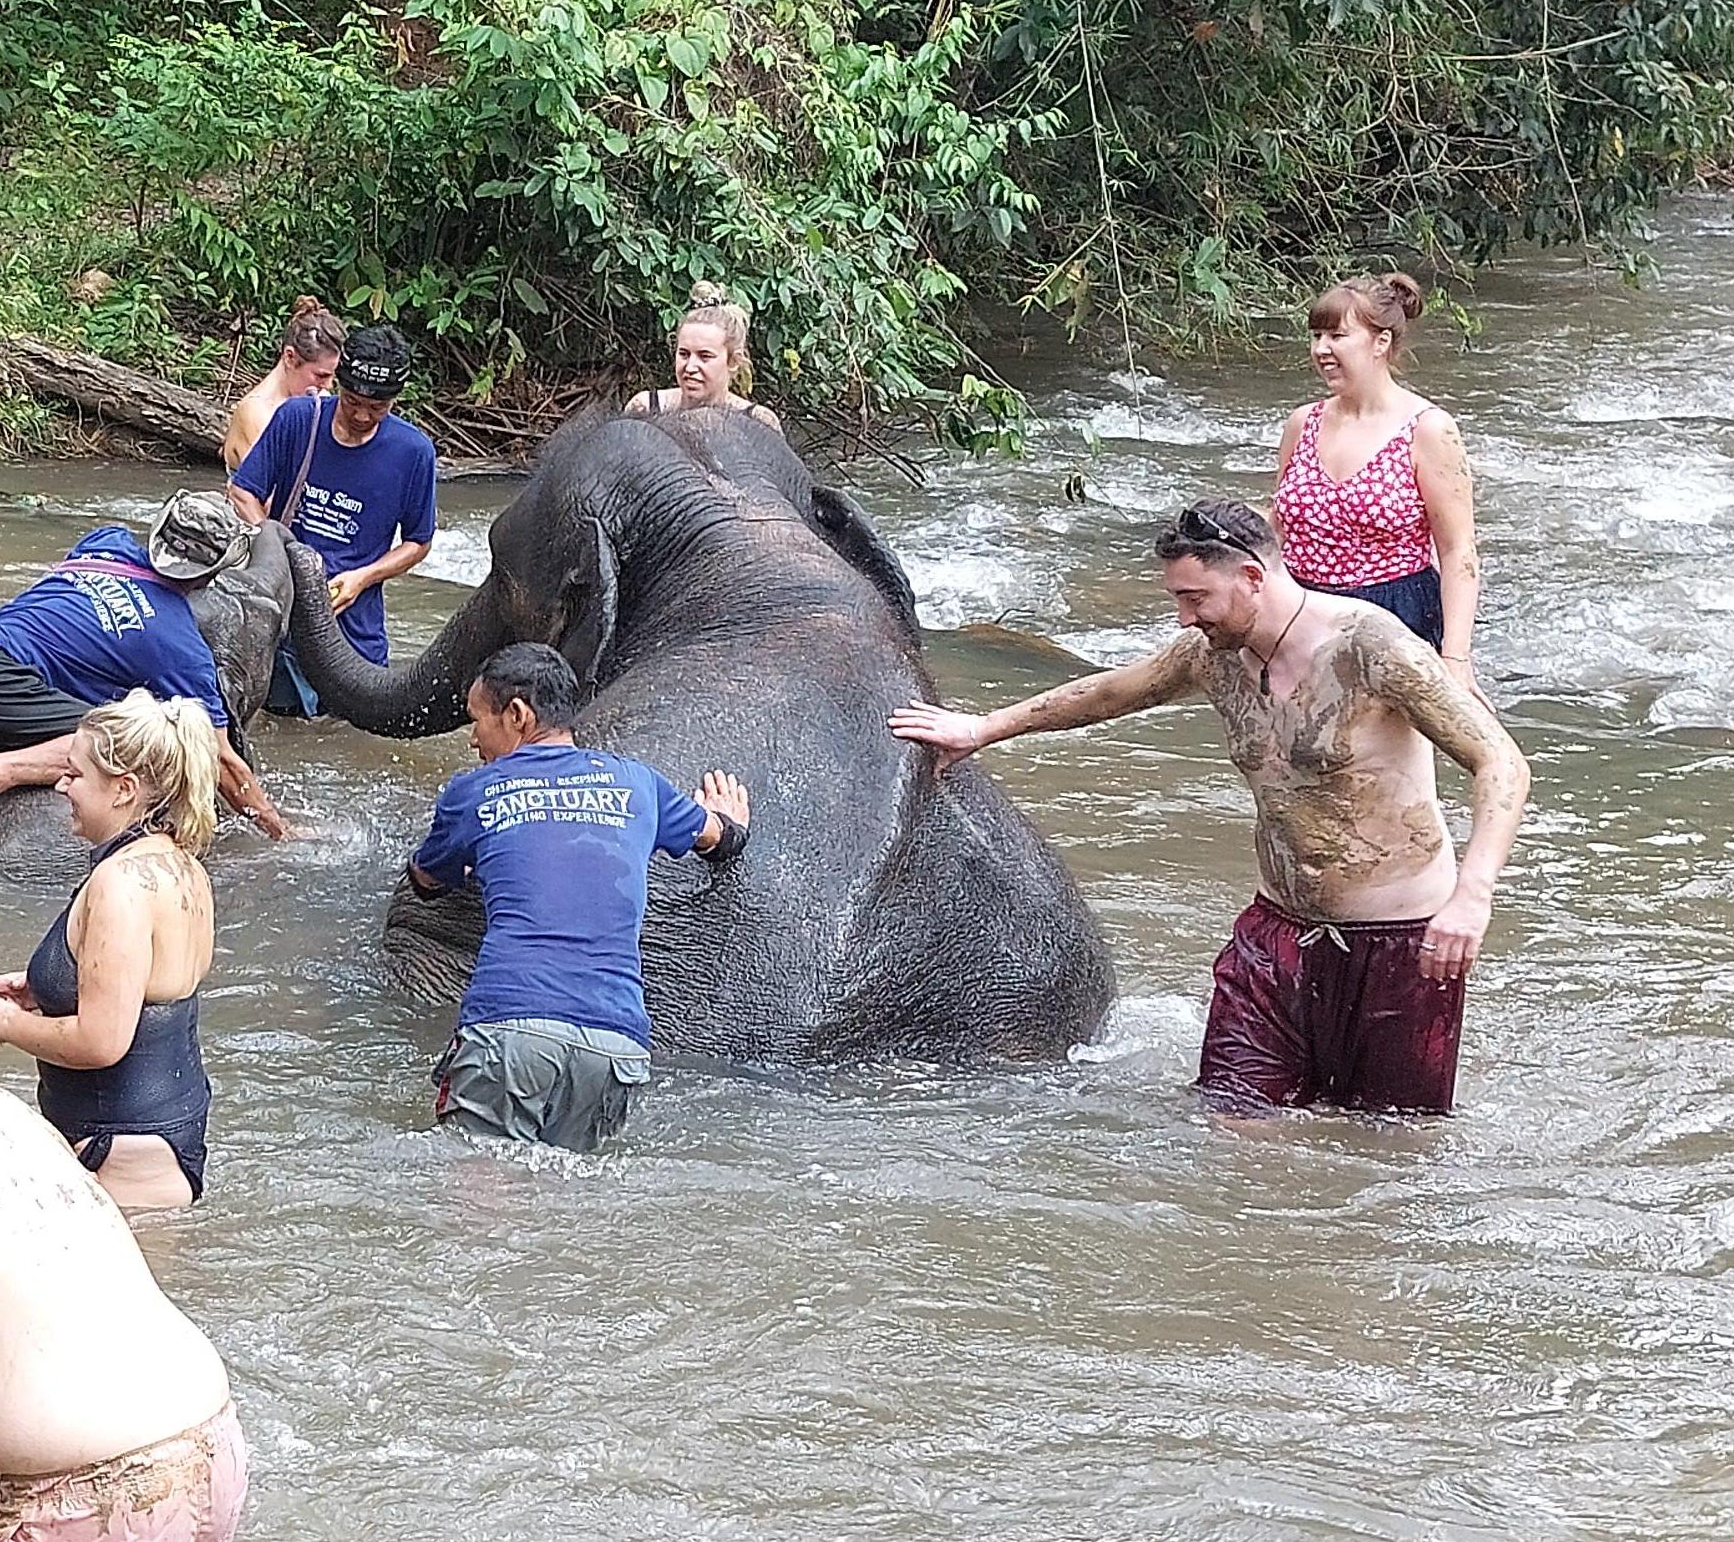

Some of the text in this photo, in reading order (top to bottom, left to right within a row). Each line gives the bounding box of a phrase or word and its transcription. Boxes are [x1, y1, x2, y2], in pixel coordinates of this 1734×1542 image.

[303, 481, 331, 505] hang
[556, 771, 616, 787] ELEPHANT
[477, 790, 633, 828] SANCTUARY
[496, 810, 627, 833] AMAZING EXPERIENCE
